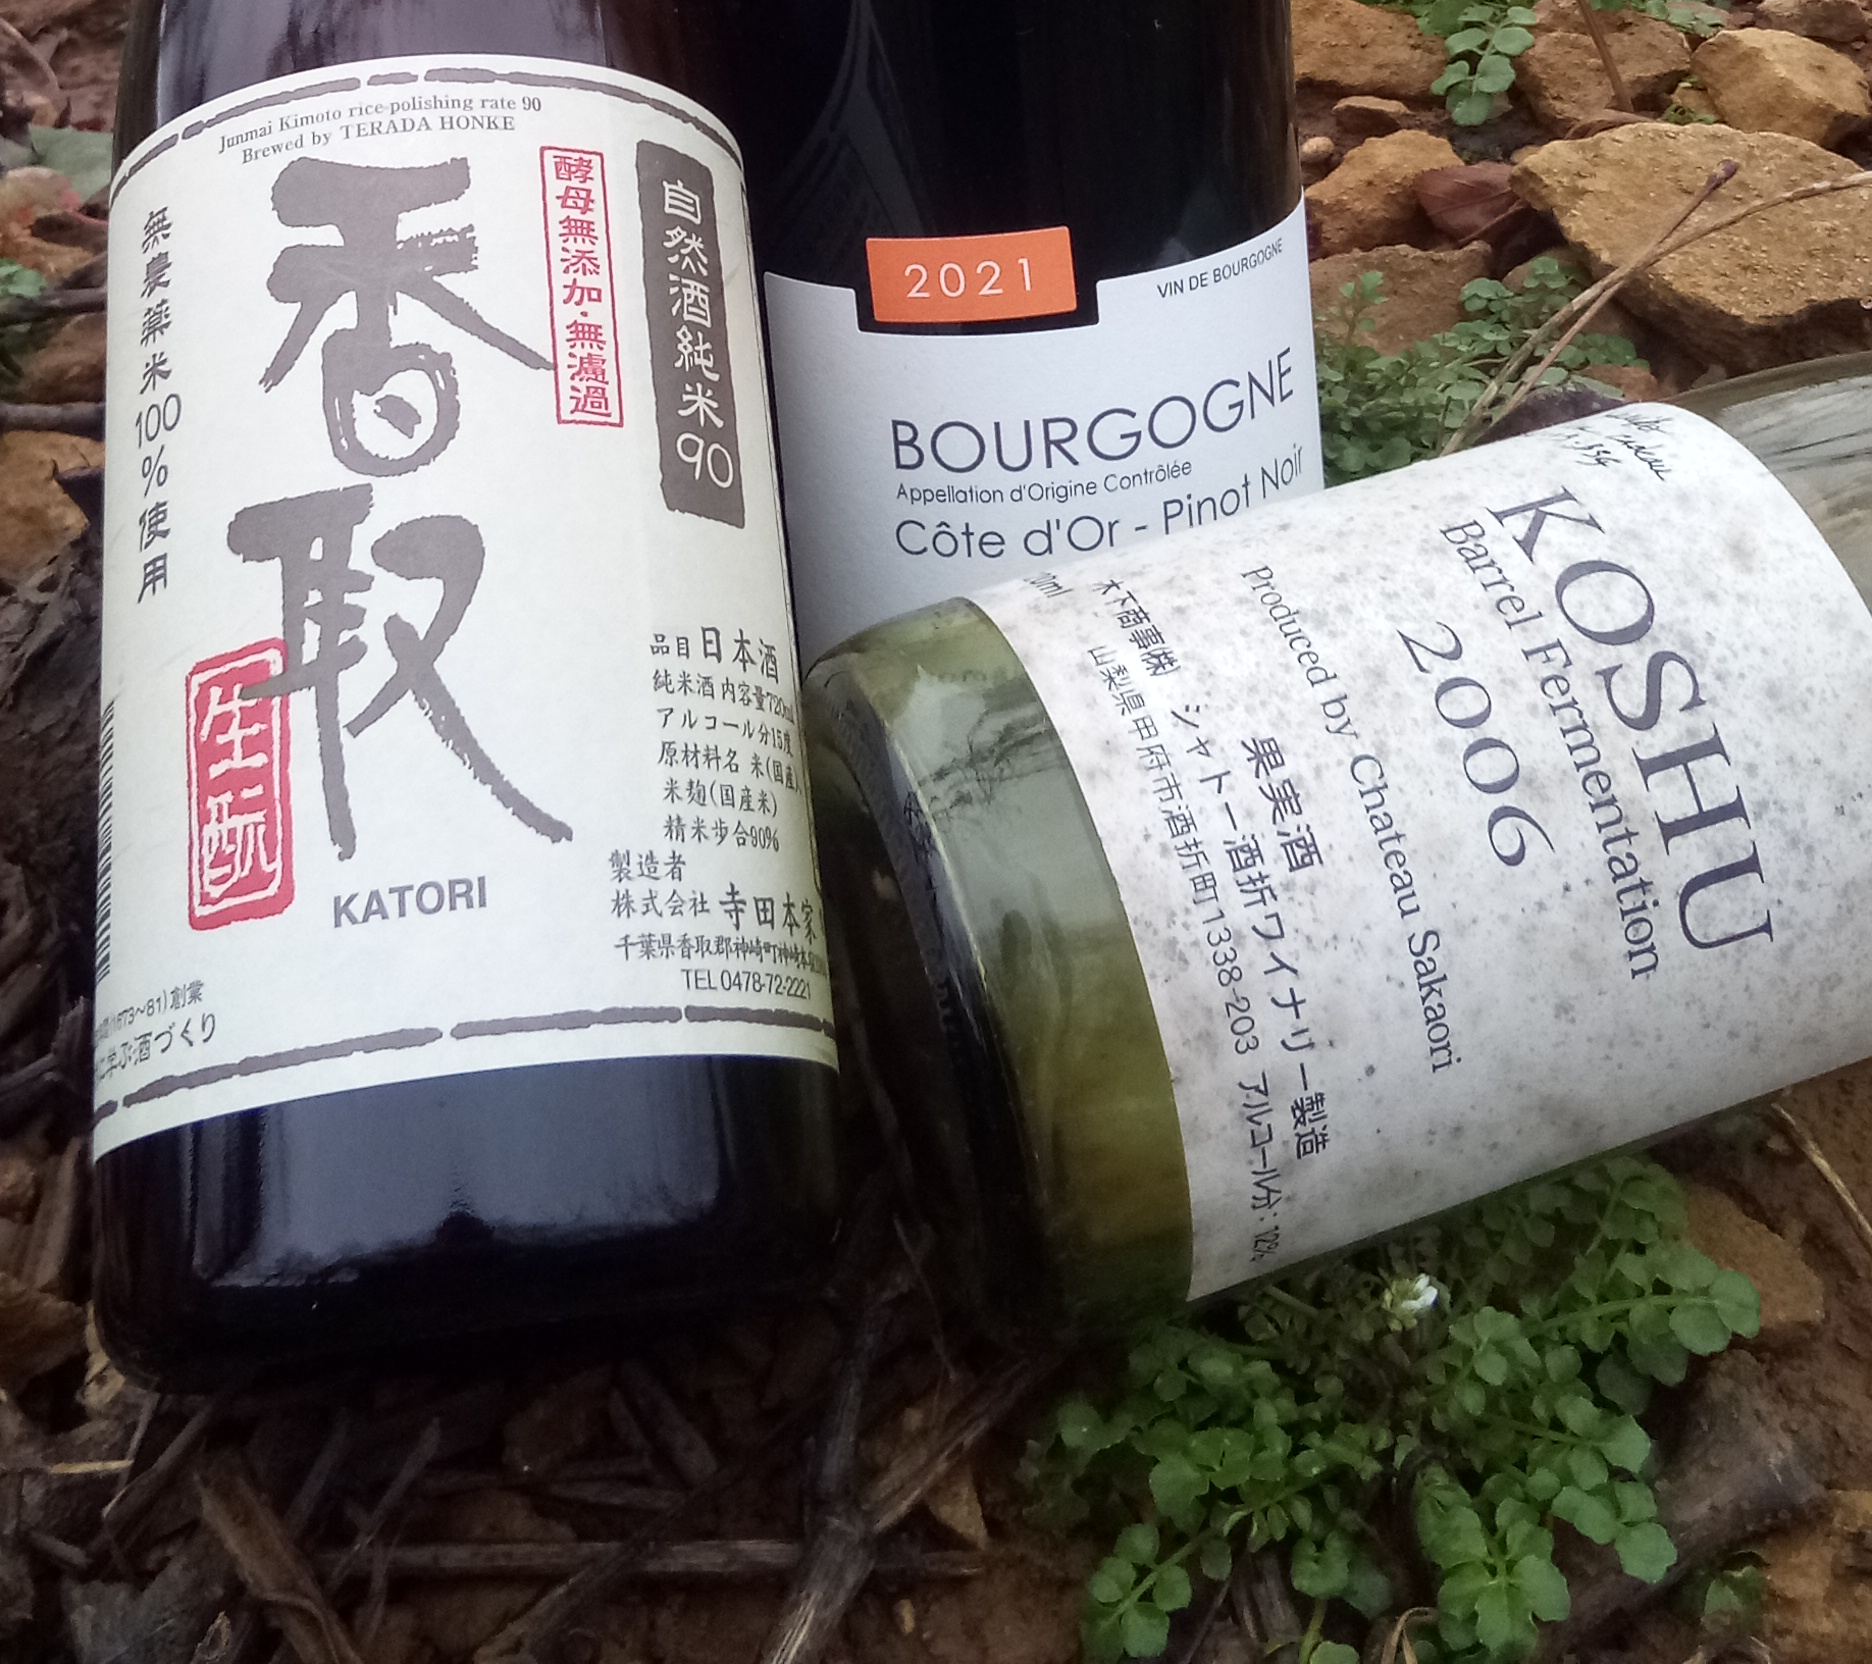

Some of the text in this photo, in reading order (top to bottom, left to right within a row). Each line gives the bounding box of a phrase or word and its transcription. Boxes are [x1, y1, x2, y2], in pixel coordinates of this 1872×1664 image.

[218, 120, 273, 154] Junmai
[279, 109, 342, 132] Kimoto
[481, 96, 517, 110] rate
[522, 96, 542, 112] 90
[241, 115, 516, 165] Brewed by TERADA HONKE
[903, 256, 1034, 300] 2021
[1157, 237, 1283, 299] VIN DE BOURGOGNE
[661, 179, 735, 489] 自然酒純米90
[891, 347, 1294, 473] BOURGOGNE
[225, 156, 575, 864] 香取
[895, 518, 1006, 559] Côte
[1023, 515, 1120, 558] d'Or
[1163, 474, 1253, 536] Pinot
[1260, 442, 1304, 500] Noir
[896, 459, 1193, 506] Appellation d'Origine Contrôlée
[650, 626, 779, 685] 品目 日本酒
[652, 668, 716, 701] 純米酒
[1396, 620, 1556, 868] 2006
[1486, 485, 1774, 950] KOSHU
[657, 740, 740, 774] 原材料名
[1440, 518, 1661, 981] Barrel Fermentation
[1240, 565, 1463, 1074] Produced by Chateau Sakaori
[1241, 736, 1324, 874] 果実酒
[608, 848, 687, 884] 製造者
[332, 875, 489, 929] KATORI
[611, 881, 818, 946] 株式会社 寺田本家
[681, 967, 812, 1000] TEL 0478-72-2221
